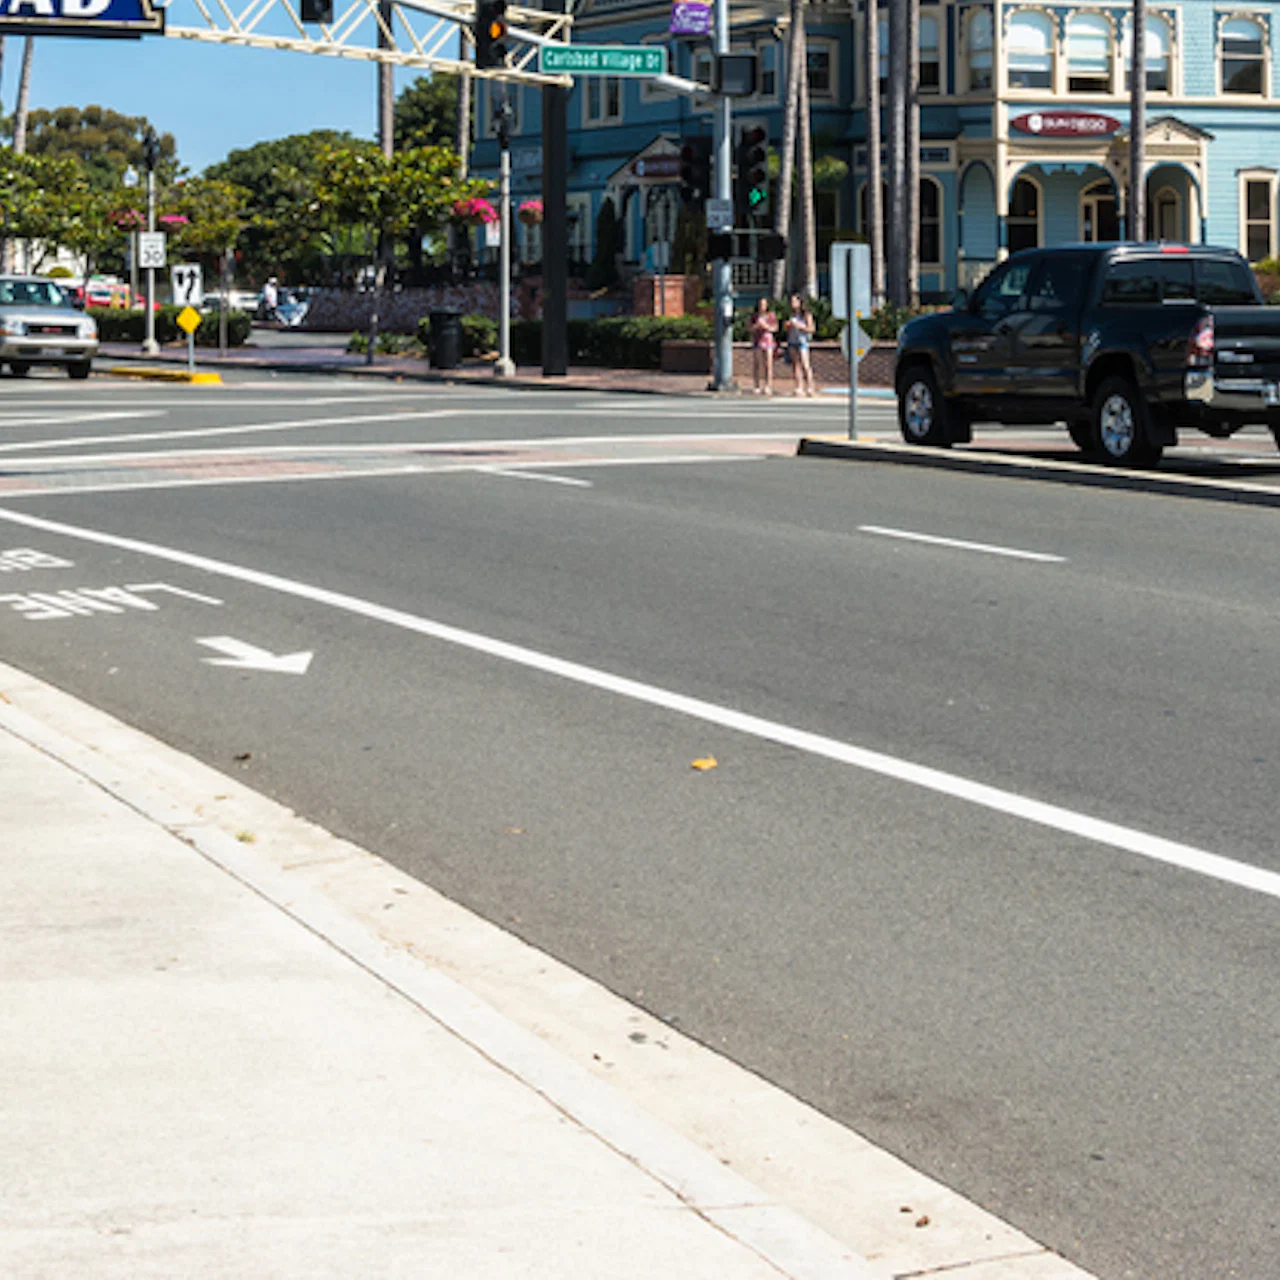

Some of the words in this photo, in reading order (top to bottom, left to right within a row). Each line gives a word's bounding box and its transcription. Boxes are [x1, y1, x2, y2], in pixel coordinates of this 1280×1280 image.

[545, 50, 599, 67] Carlsbad
[601, 50, 643, 71] Village
[645, 52, 661, 69] Dr
